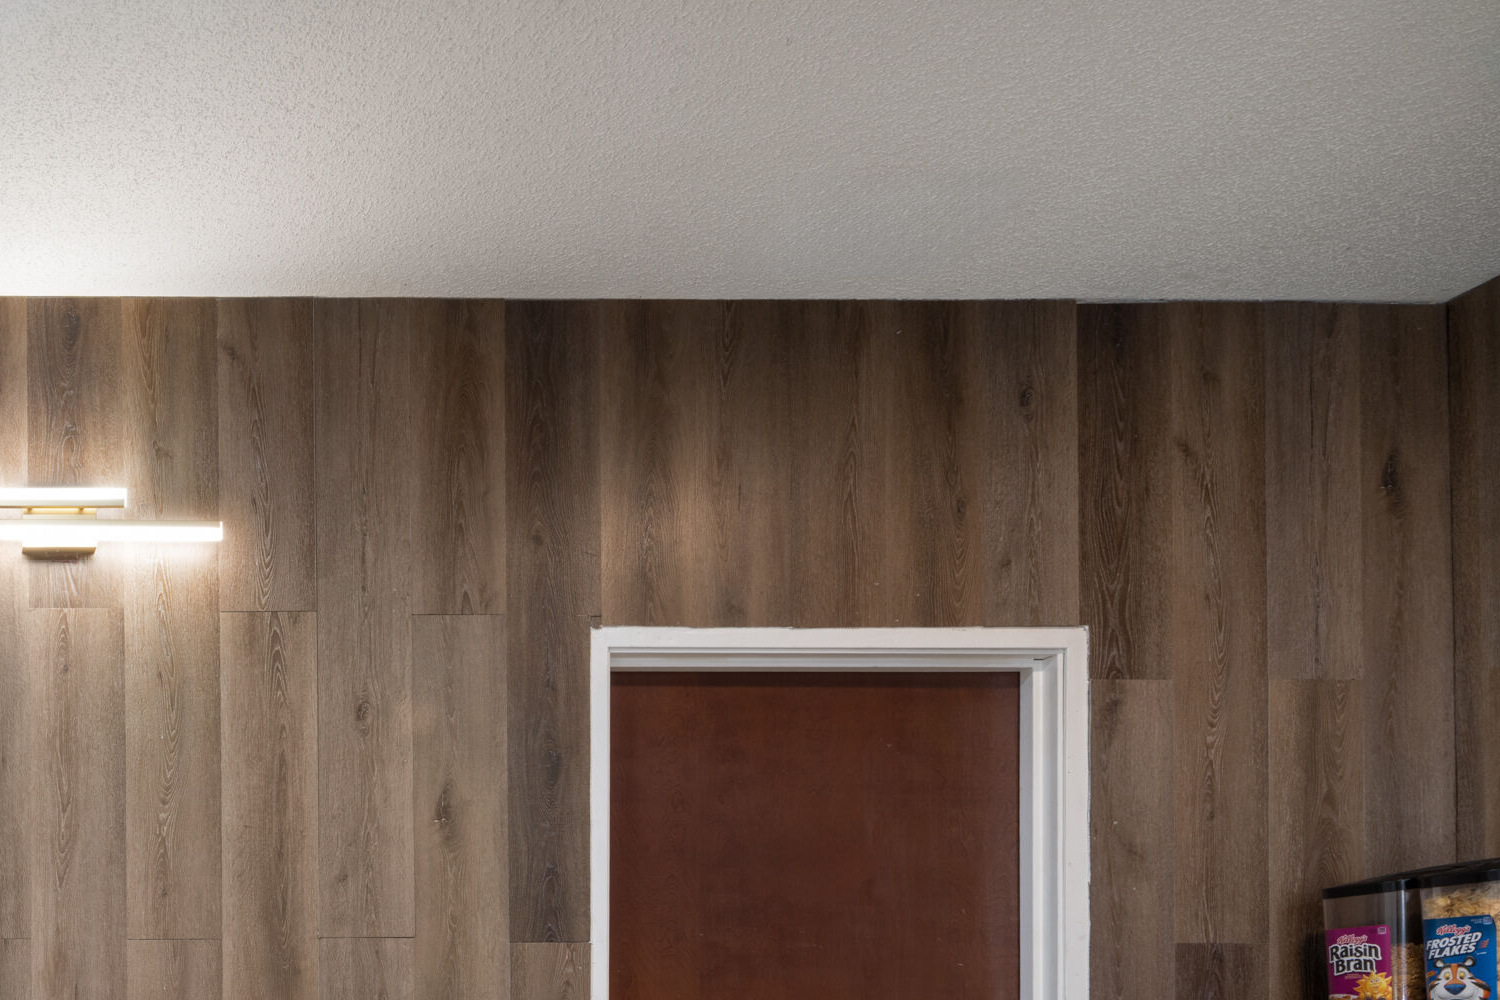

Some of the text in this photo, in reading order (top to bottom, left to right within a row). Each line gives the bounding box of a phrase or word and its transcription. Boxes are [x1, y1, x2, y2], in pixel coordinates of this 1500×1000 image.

[1426, 932, 1482, 951] FROSTED
[1329, 943, 1382, 962] Raisin
[1428, 942, 1477, 960] FLAKES
[1334, 958, 1377, 976] Bran
